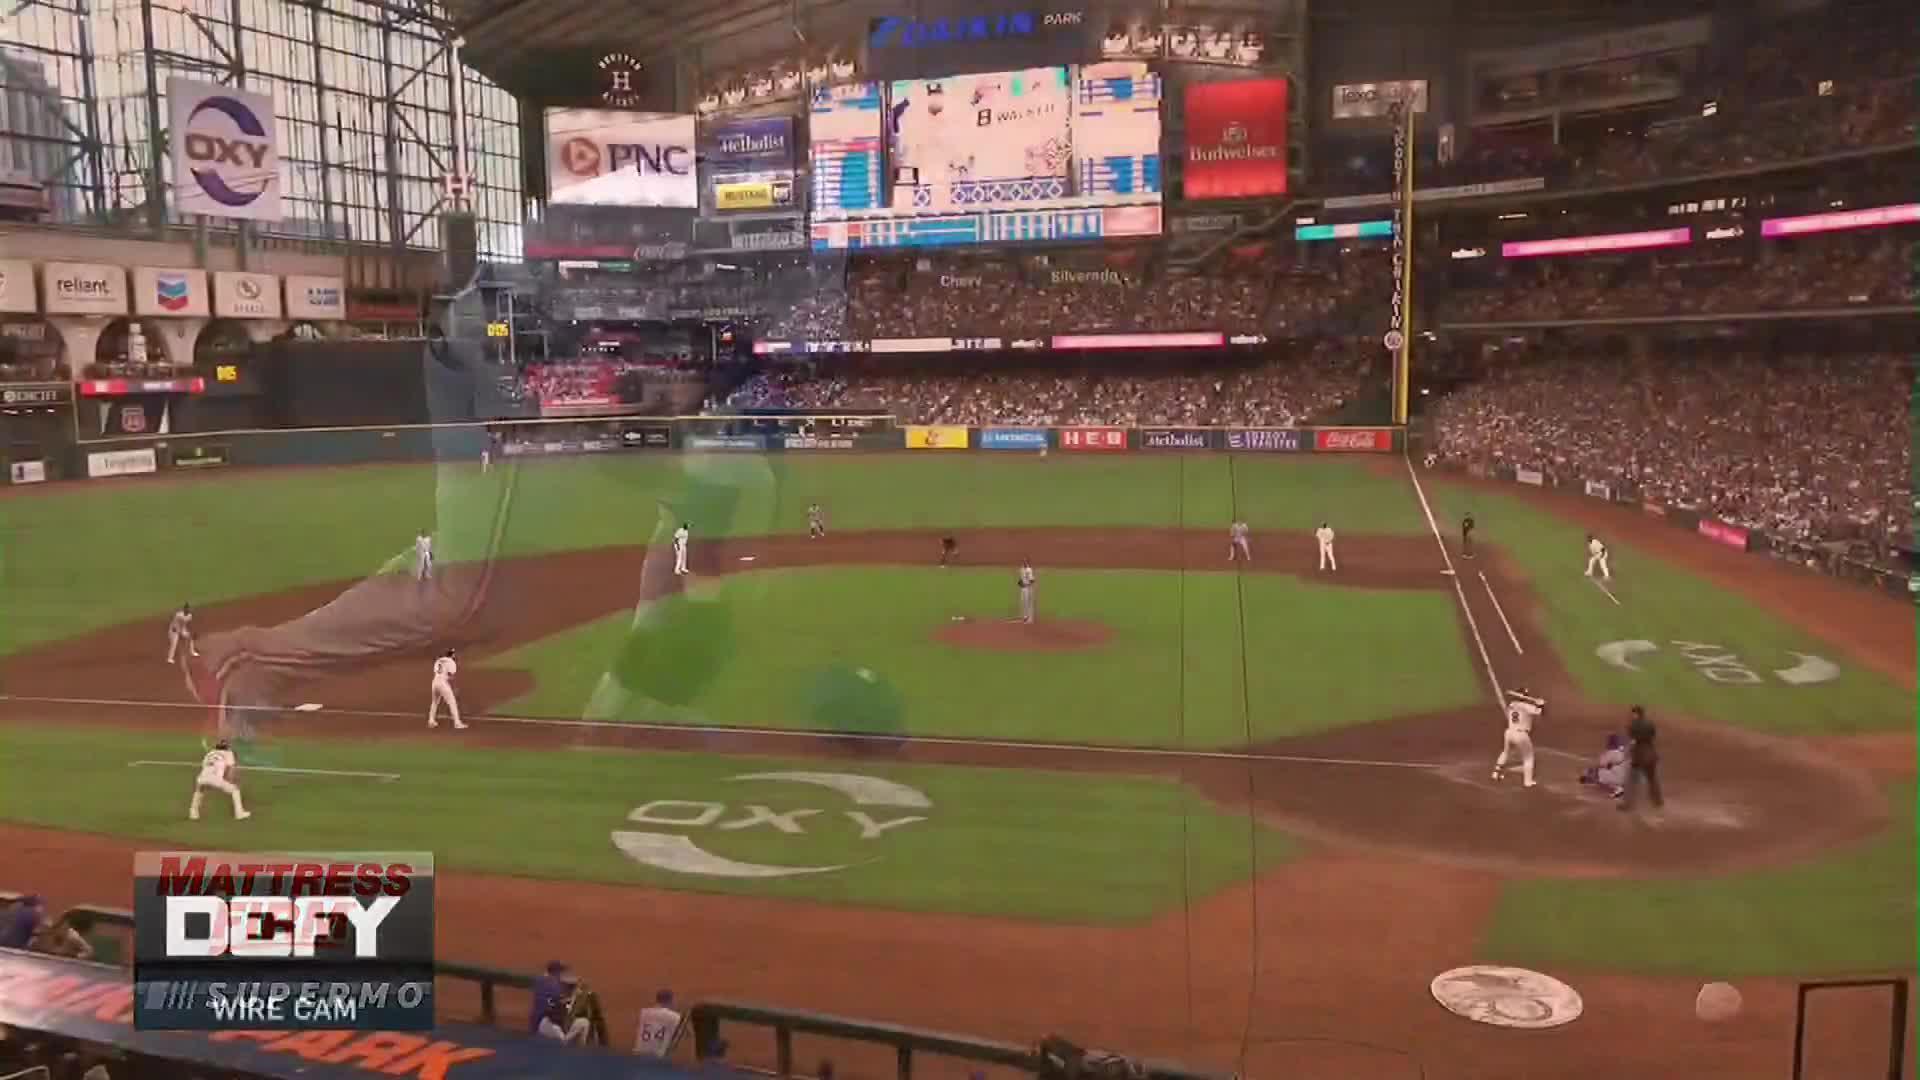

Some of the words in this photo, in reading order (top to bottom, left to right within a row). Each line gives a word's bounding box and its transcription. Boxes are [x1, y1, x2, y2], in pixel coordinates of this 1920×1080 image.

[1043, 11, 1092, 25] PARK
[185, 133, 269, 168] OXY
[1189, 144, 1275, 161] Budweiser
[606, 143, 690, 176] PNC
[57, 276, 109, 293] reliant
[1050, 268, 1118, 285] Silverado
[627, 800, 929, 838] OXY
